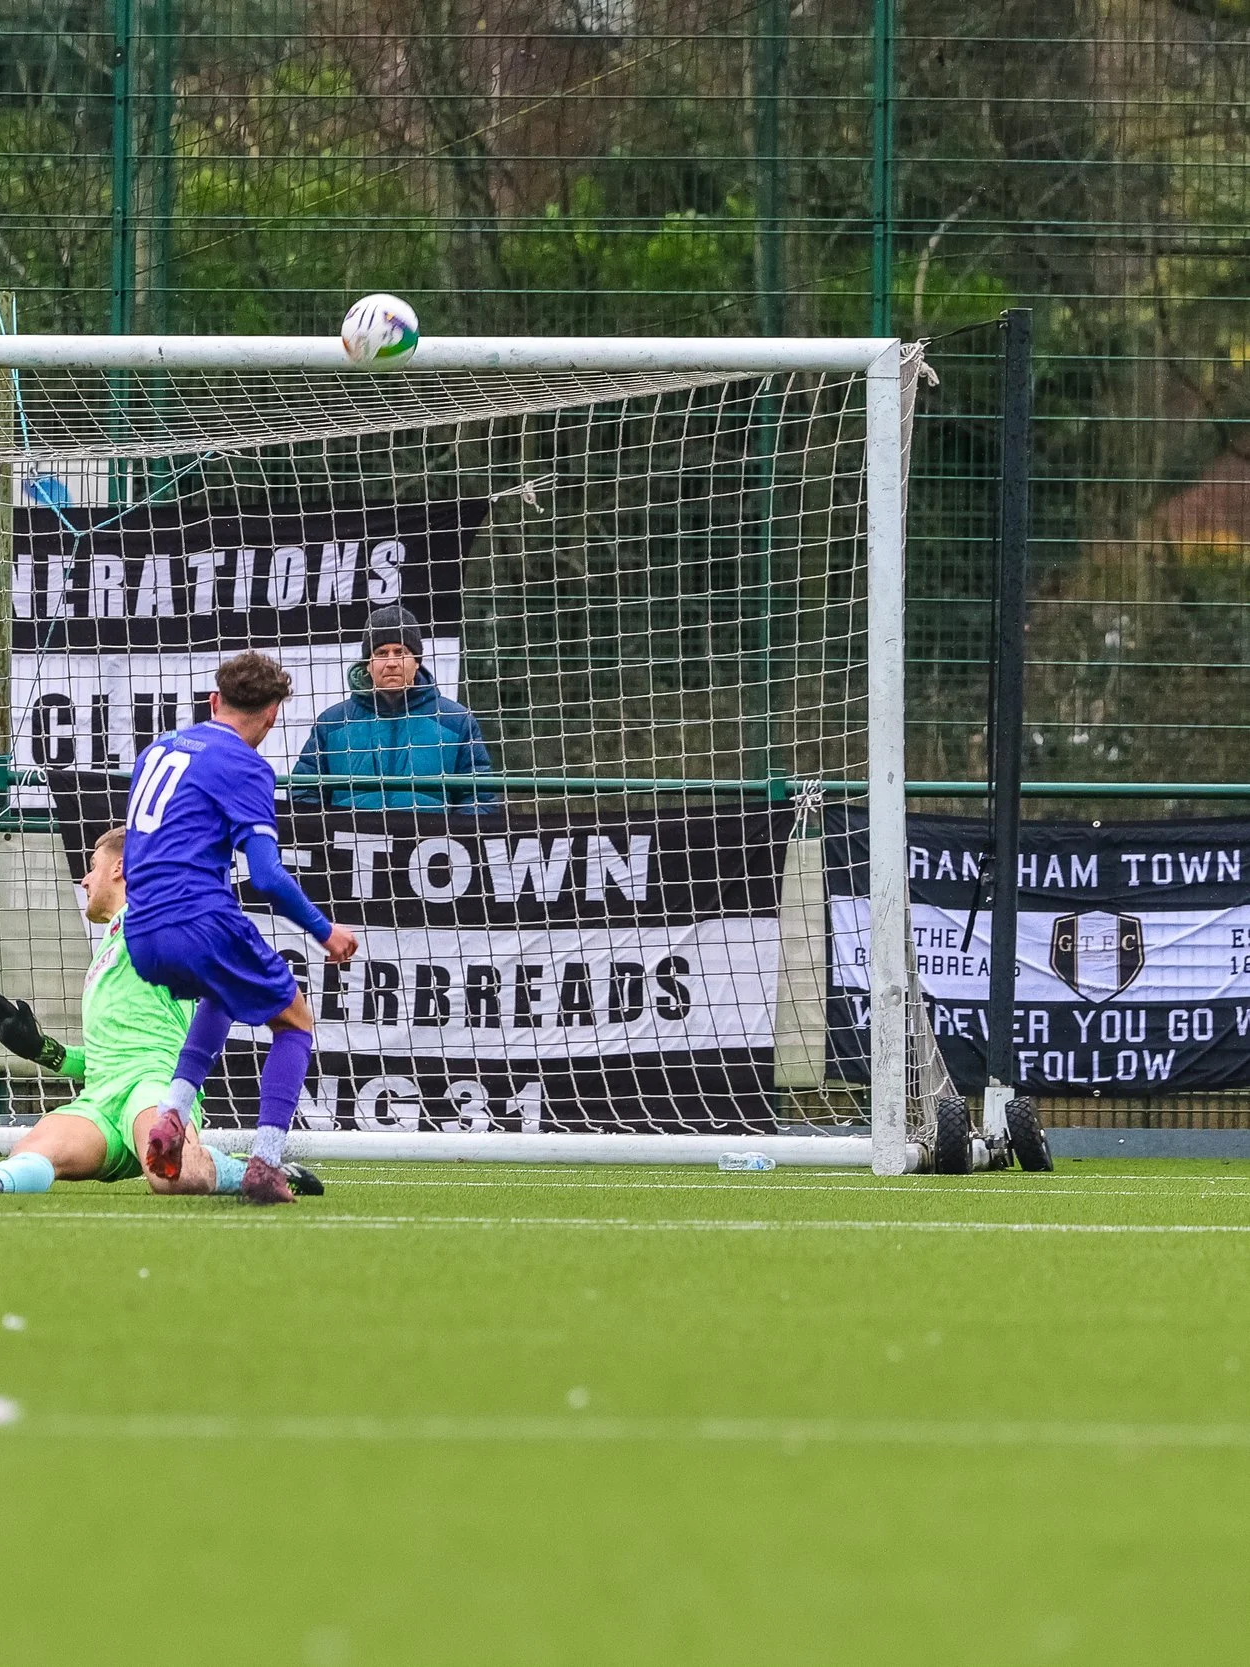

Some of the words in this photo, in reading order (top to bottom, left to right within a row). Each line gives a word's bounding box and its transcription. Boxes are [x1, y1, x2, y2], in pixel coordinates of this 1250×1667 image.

[32, 692, 220, 769] CLU
[126, 746, 191, 834] 10
[1121, 849, 1241, 887] TOWN
[913, 927, 958, 949] THE
[1073, 1009, 1146, 1043] YOU
[1168, 1007, 1214, 1042] GO
[1018, 1049, 1176, 1083] FOLLOW
